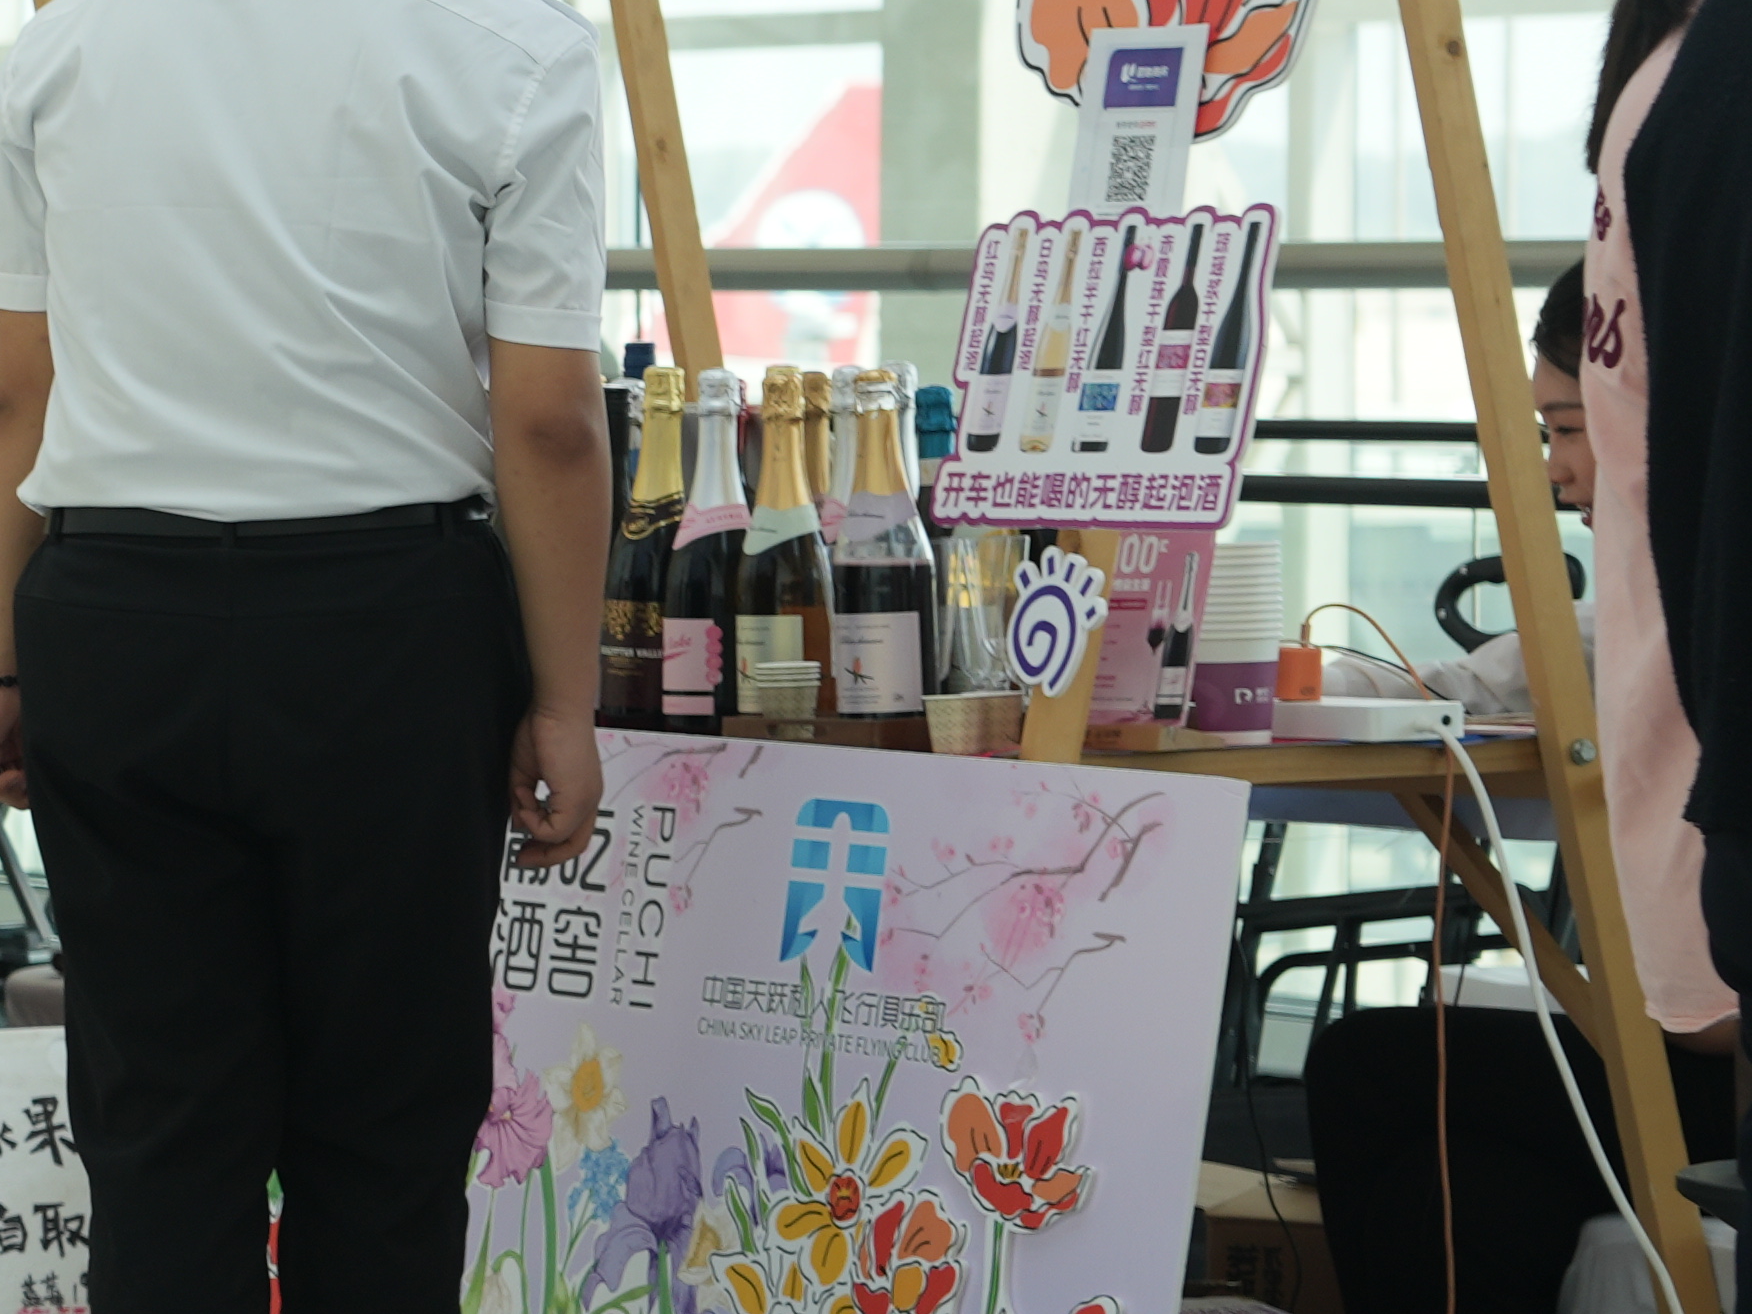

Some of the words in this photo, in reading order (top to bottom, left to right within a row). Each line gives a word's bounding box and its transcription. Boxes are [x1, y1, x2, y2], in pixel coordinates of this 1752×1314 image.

[941, 472, 1224, 512] 开车也能喝的无醇起泡酒
[623, 805, 646, 879] WINE
[629, 806, 677, 1009] PUCHI
[609, 888, 635, 1007] CELLAR
[697, 1017, 737, 1037] CHINA
[738, 1022, 764, 1041] SKY
[765, 1026, 798, 1046] LEAP
[800, 1029, 854, 1055] PRIVATE
[855, 1036, 905, 1060] FLYING
